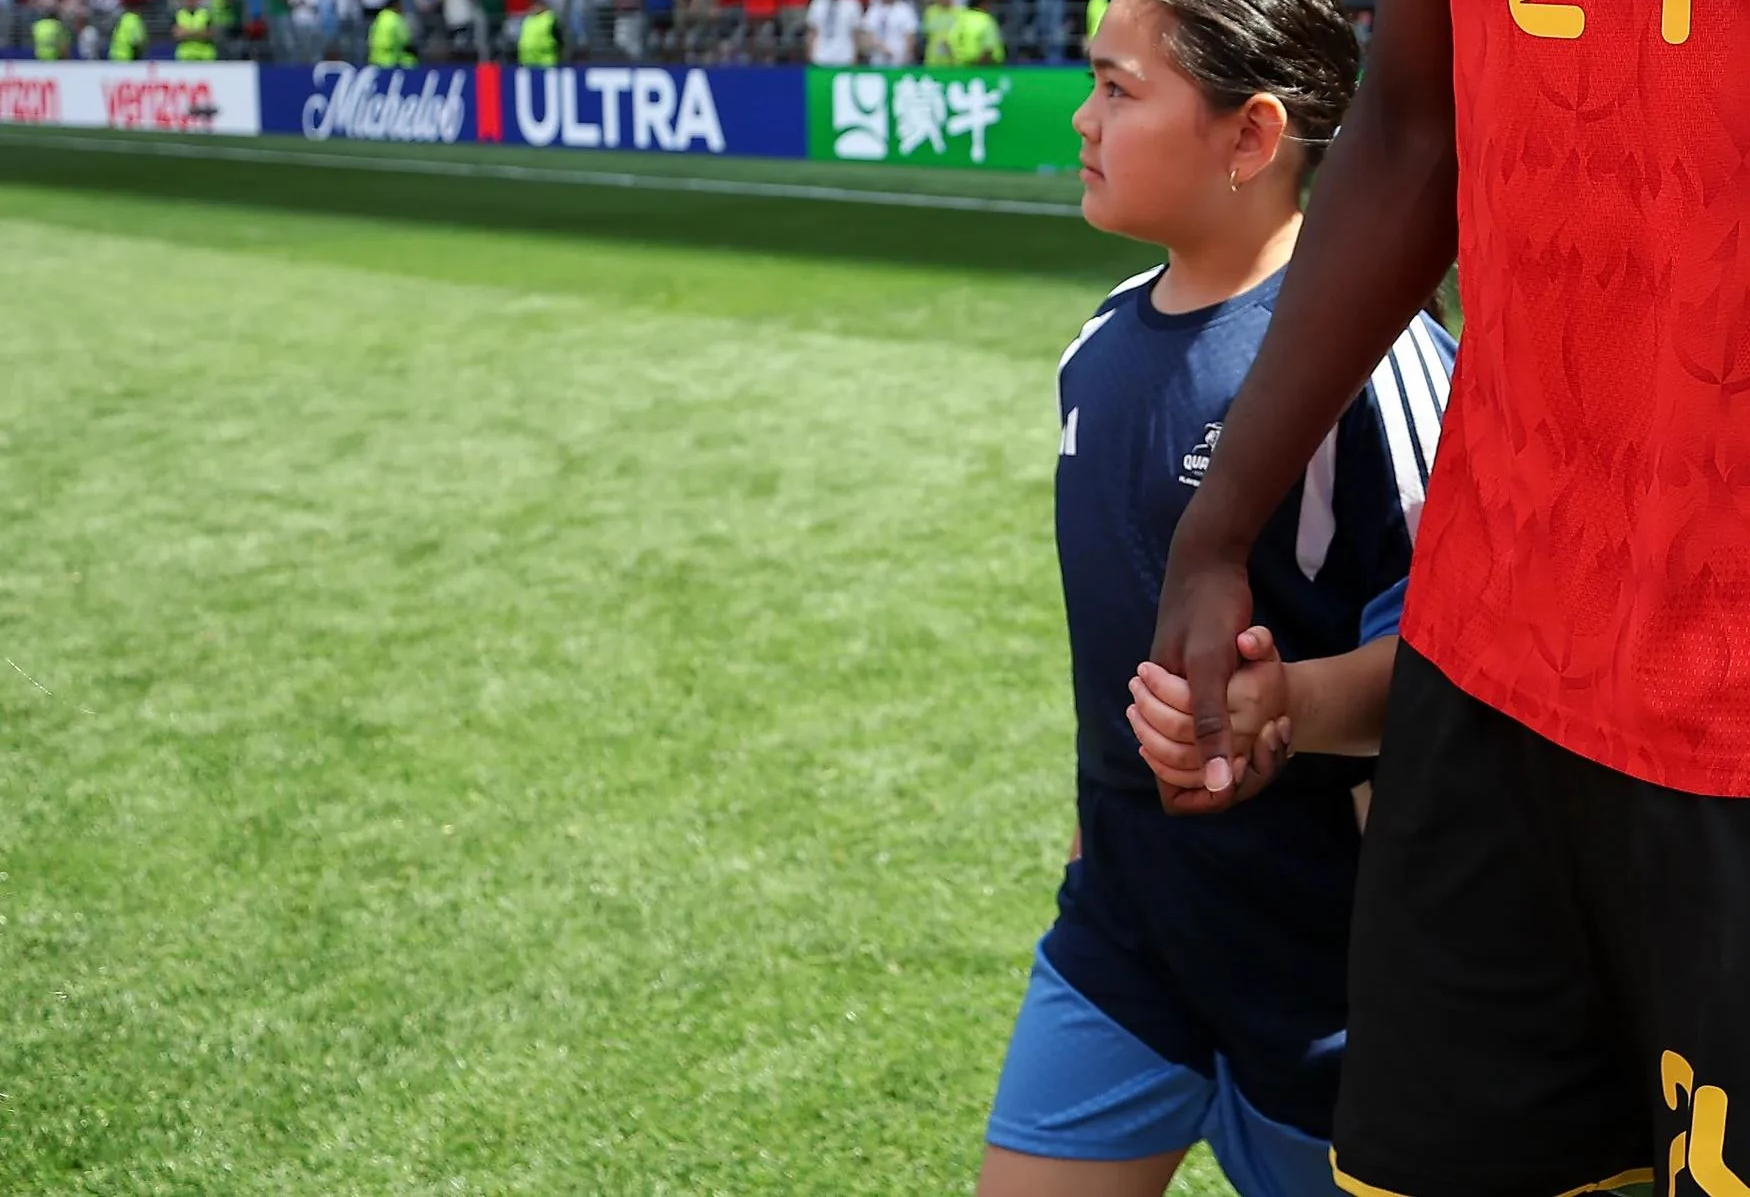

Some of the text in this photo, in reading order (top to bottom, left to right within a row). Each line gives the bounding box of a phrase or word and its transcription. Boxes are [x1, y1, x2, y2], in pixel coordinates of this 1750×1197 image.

[302, 60, 726, 153] Michelob ULTRA
[893, 73, 1003, 163] 蒙牛
[1183, 454, 1210, 471] QUA
